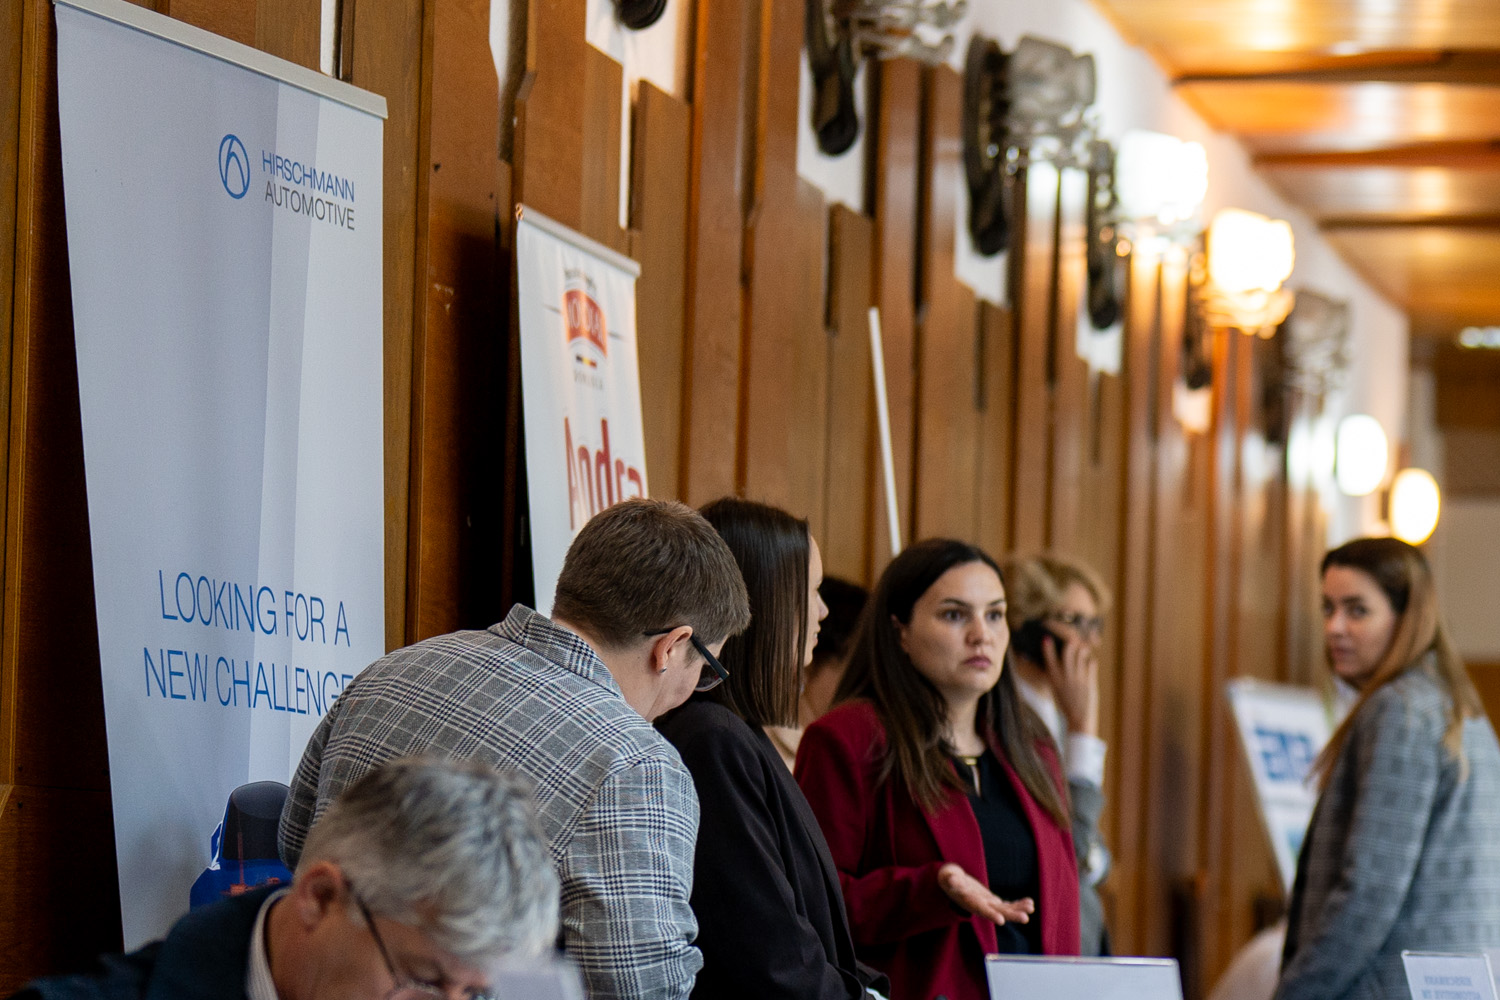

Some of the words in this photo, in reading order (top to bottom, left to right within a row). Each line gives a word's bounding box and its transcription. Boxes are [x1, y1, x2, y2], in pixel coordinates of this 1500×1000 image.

[262, 150, 355, 202] HIRSCHMANN
[265, 180, 355, 230] AUTOMOTIVE
[159, 570, 277, 635] LOOKING
[285, 590, 326, 644] FOR
[334, 601, 350, 647] A
[144, 647, 208, 702] NEW
